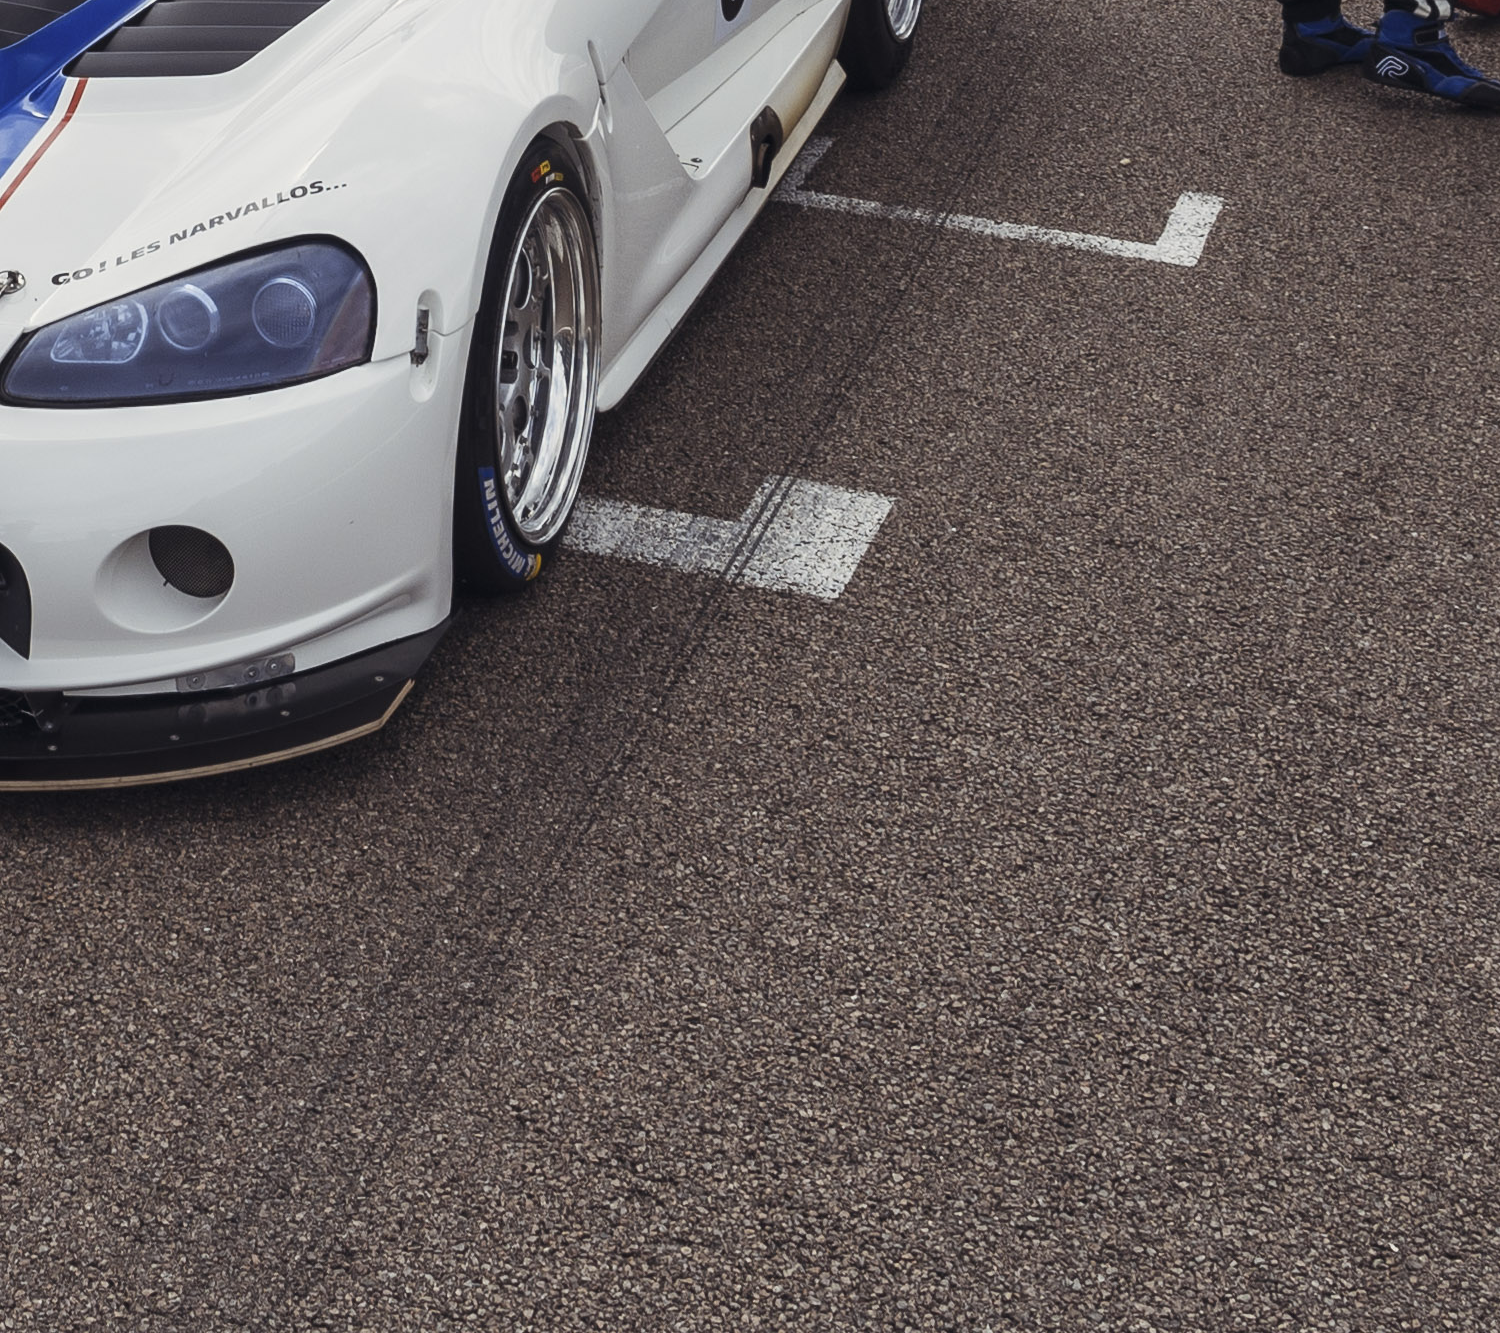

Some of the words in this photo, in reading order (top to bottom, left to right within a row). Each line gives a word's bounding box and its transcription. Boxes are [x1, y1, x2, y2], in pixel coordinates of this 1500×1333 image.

[116, 241, 161, 267] LES
[169, 180, 348, 245] NARVALLOS...
[482, 477, 528, 579] MICHELIN
